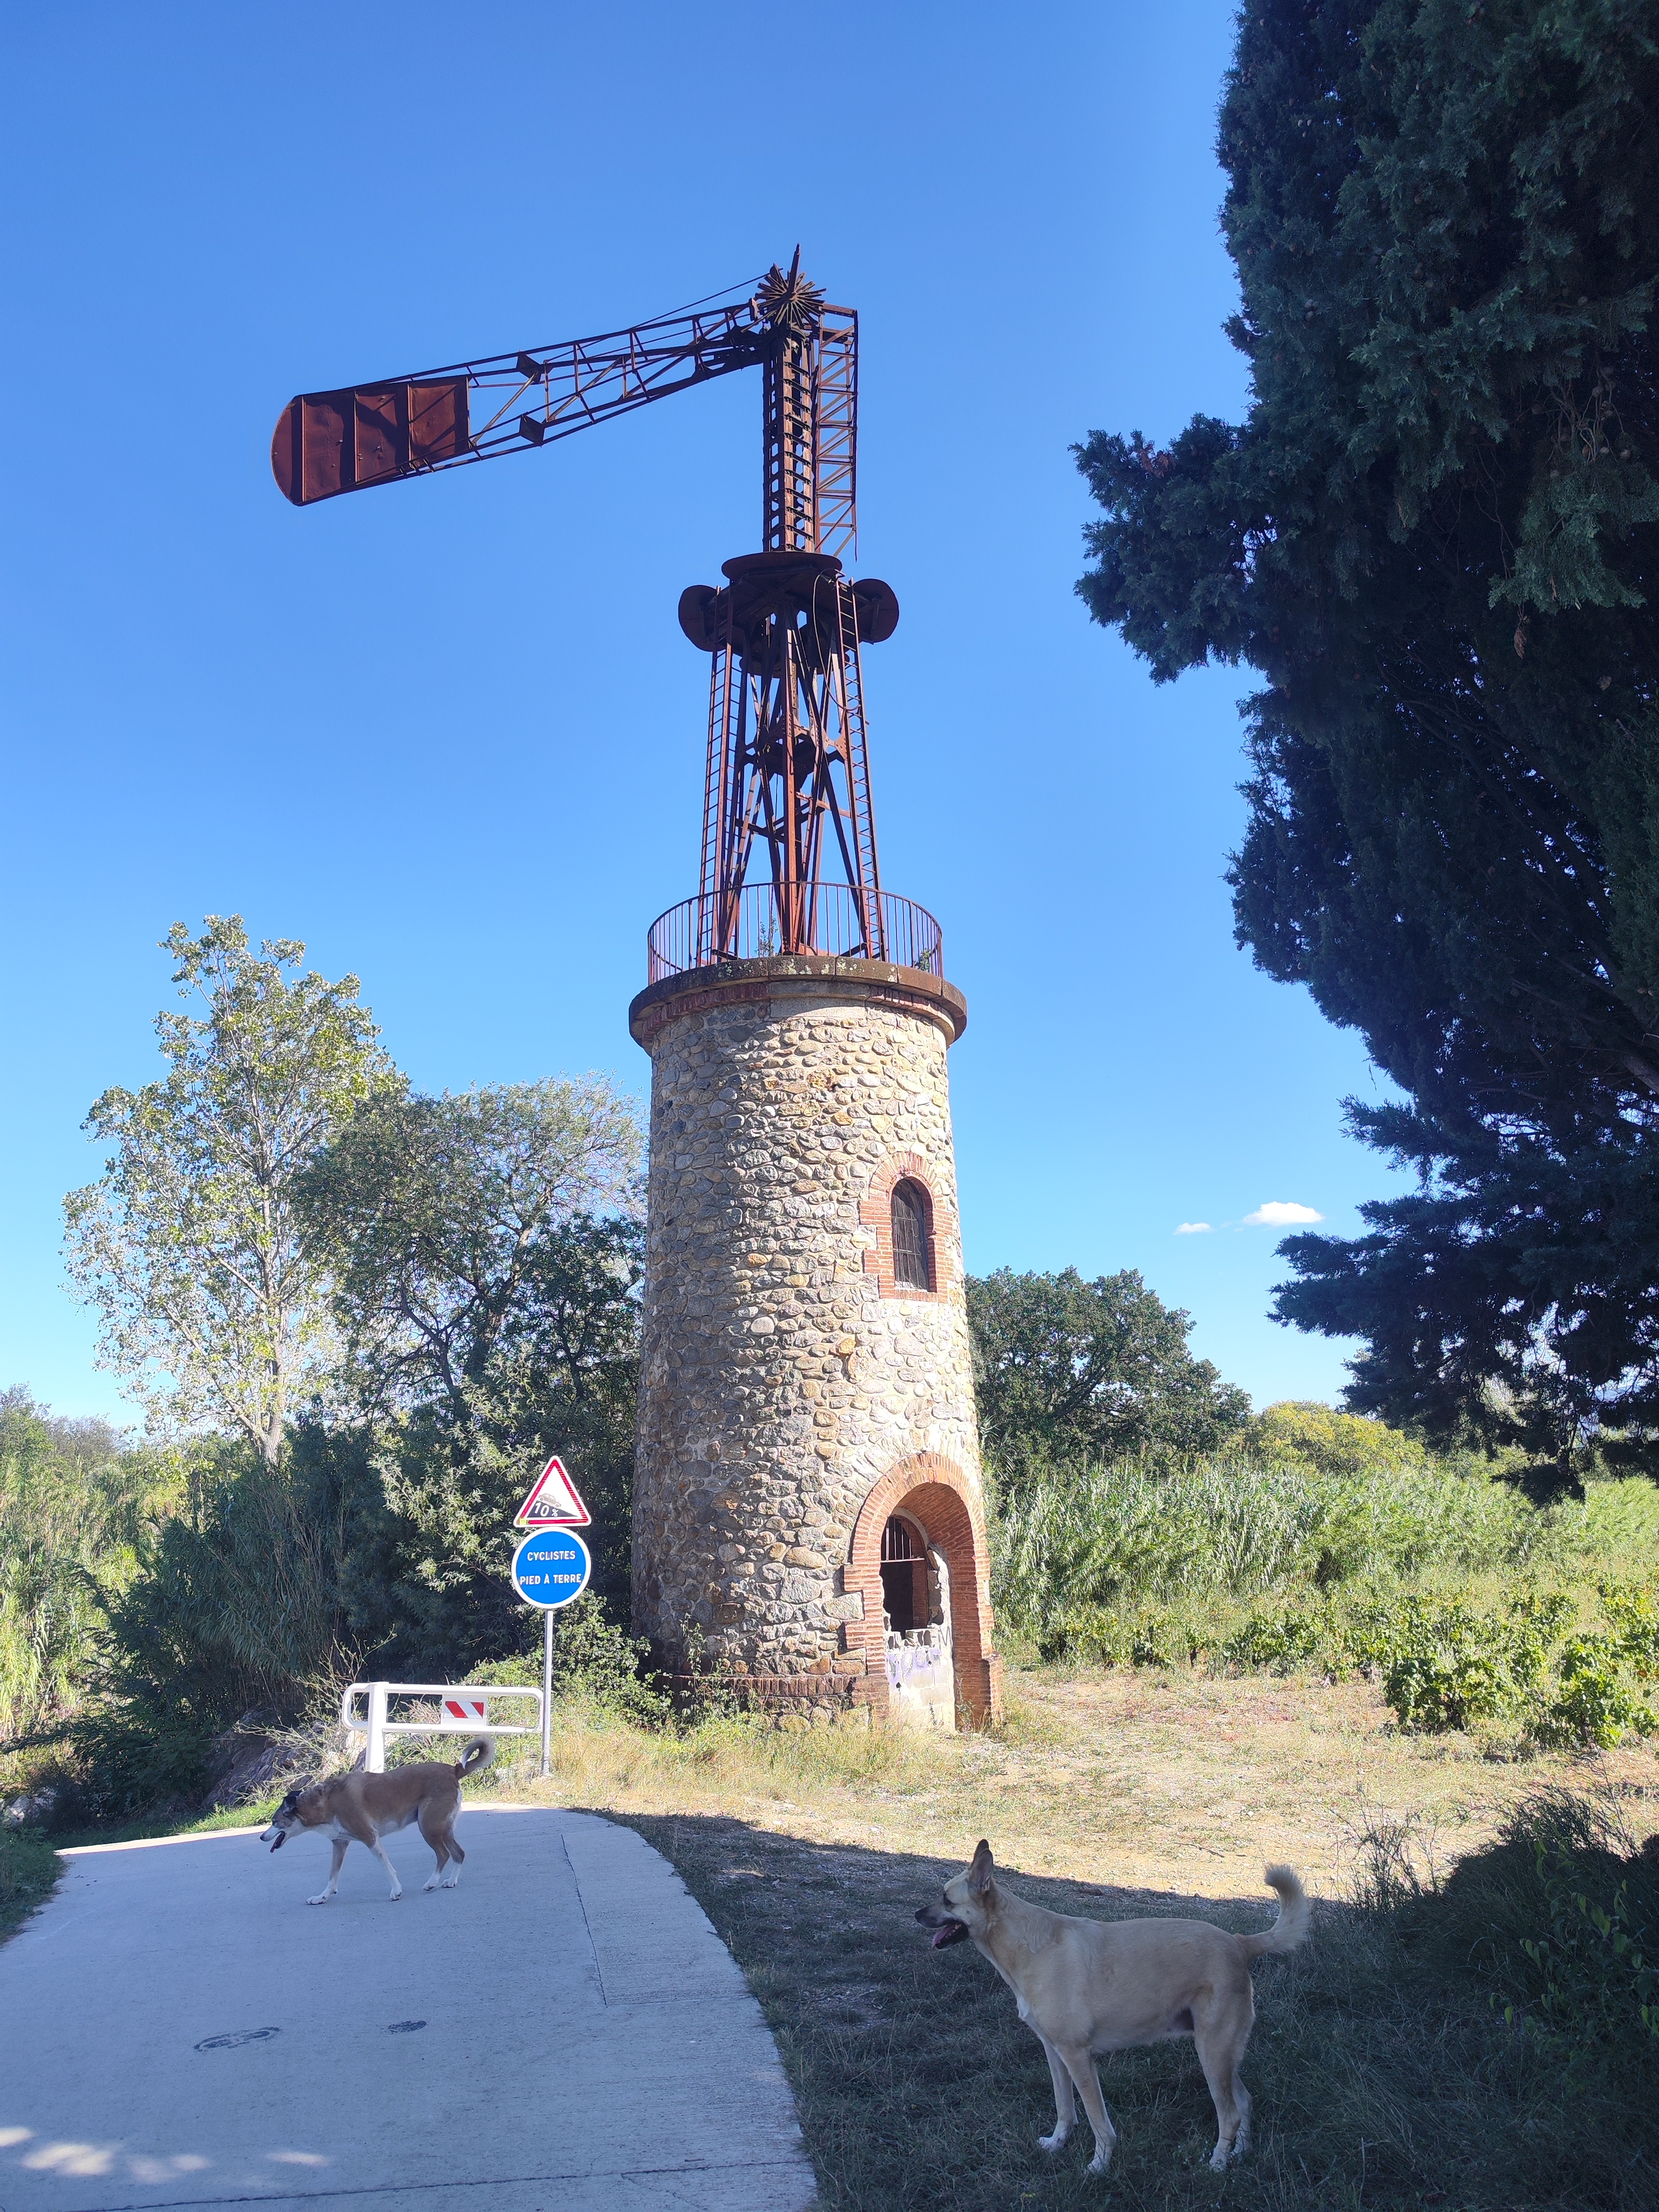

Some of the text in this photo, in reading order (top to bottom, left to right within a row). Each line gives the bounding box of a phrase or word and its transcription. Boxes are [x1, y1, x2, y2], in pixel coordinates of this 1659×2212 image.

[527, 1550, 576, 1561] CYCLISTES
[520, 1574, 582, 1585] PIED À TERRE
